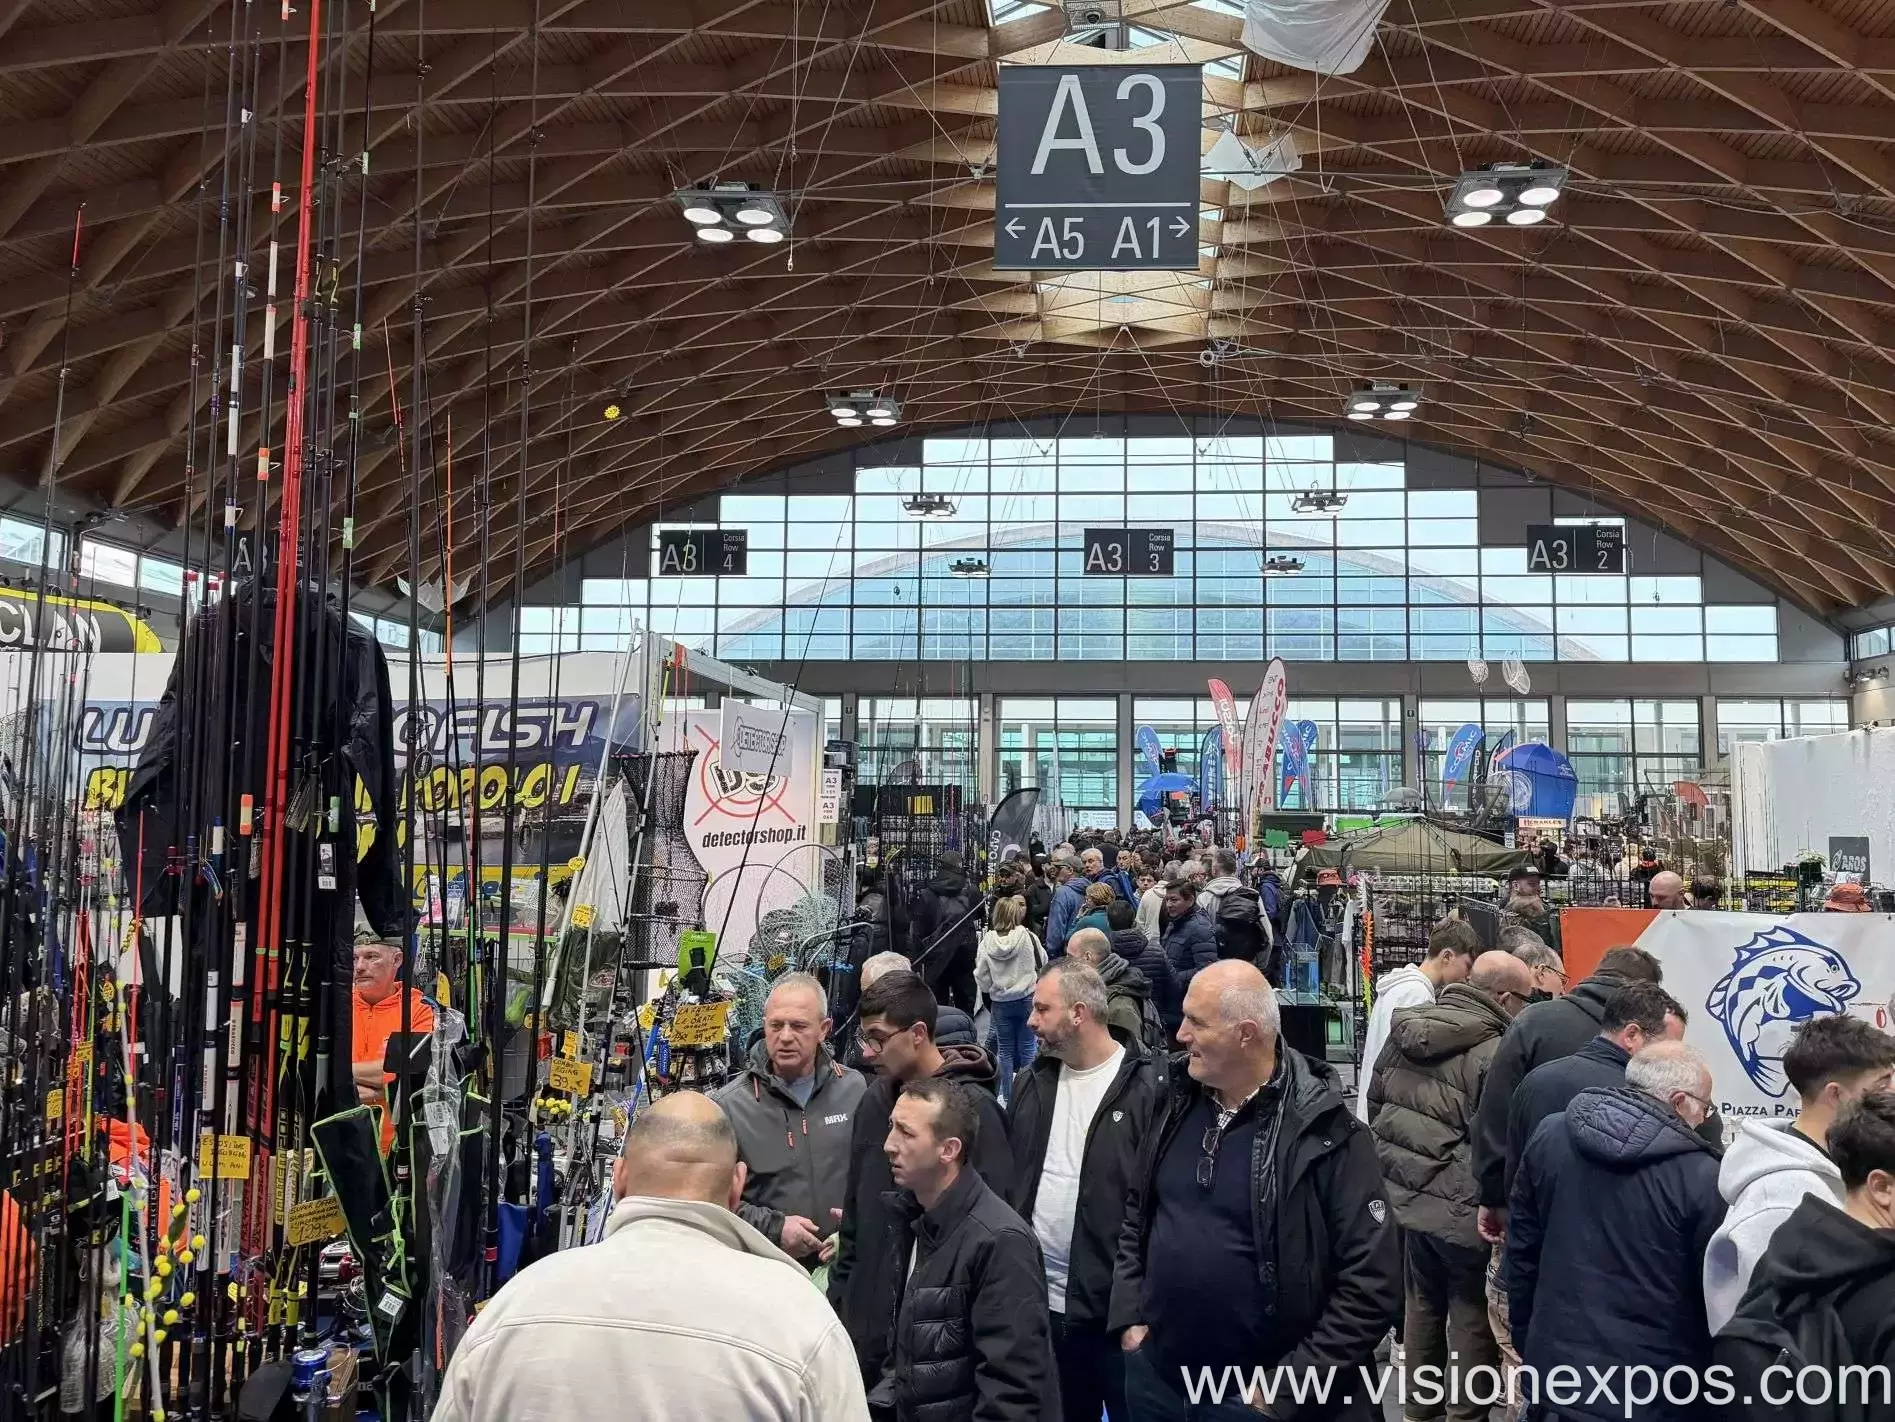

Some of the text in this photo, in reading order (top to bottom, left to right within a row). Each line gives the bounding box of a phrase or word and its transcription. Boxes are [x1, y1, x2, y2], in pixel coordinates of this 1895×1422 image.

[1030, 73, 1166, 175] A3
[1030, 216, 1160, 260] A5 A1
[723, 533, 745, 543] Corsia
[1148, 533, 1172, 542] Corsia
[1596, 529, 1621, 539] Corsia
[723, 543, 740, 552] Row
[1148, 543, 1166, 552] Row
[1596, 540, 1615, 549] Row
[661, 543, 698, 572] A3
[723, 553, 734, 571] 4
[1086, 542, 1123, 572] A3
[1149, 553, 1160, 572] 3
[1529, 539, 1569, 570] A3
[1597, 550, 1609, 570] 2
[823, 802, 834, 810] A3
[702, 824, 807, 849] detectorshop.it
[985, 829, 1001, 860] CAPO
[1721, 1102, 1768, 1116] PIAZZA
